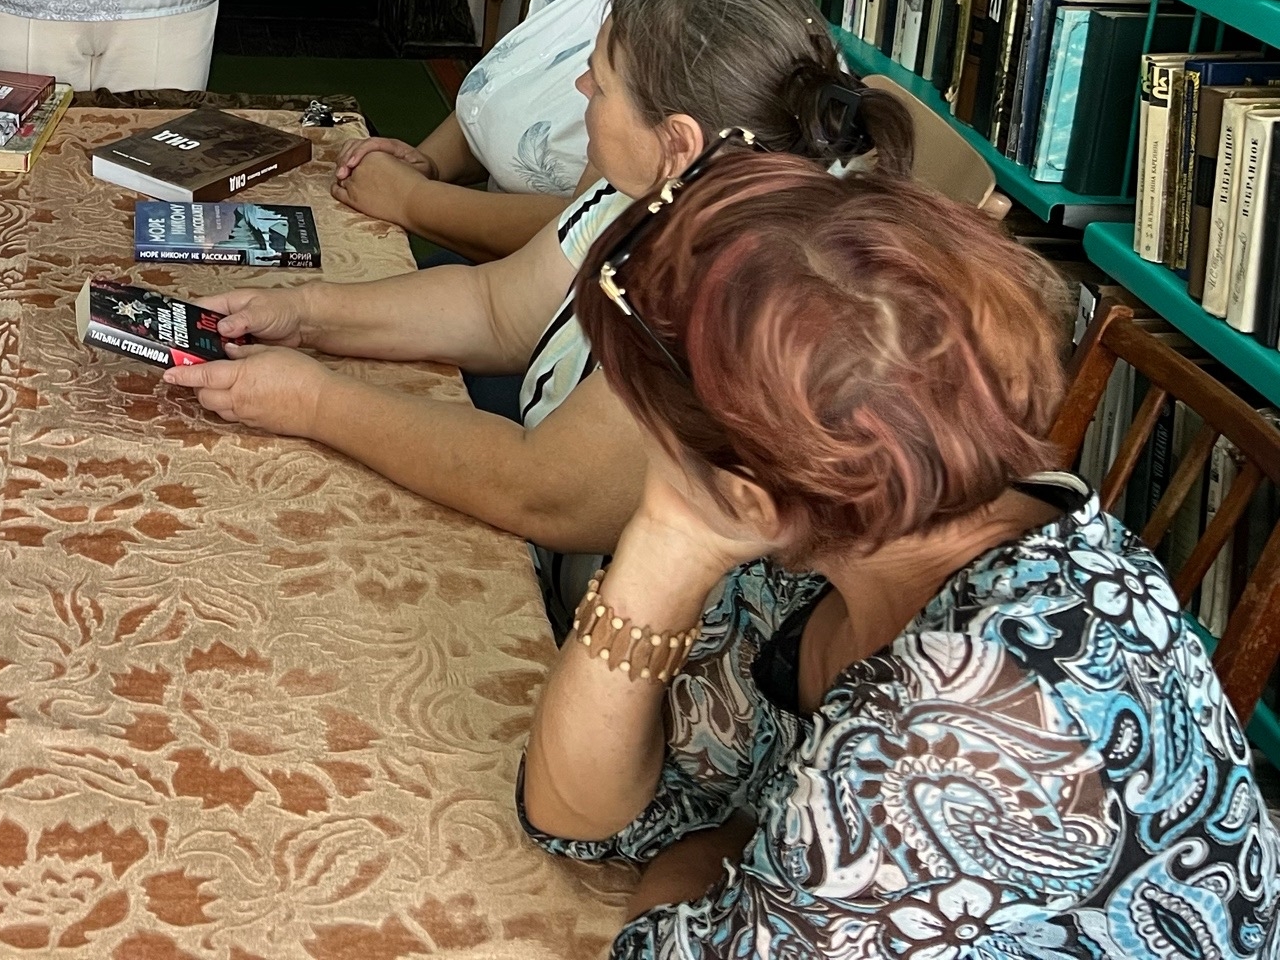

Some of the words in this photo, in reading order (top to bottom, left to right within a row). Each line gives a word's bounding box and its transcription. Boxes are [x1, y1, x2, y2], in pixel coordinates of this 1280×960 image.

[152, 129, 200, 150] СИД
[1220, 125, 1233, 203] ИЗБРАННОЕ
[1242, 137, 1259, 217] ИЗБРАННОЕ
[229, 173, 246, 192] СИД
[148, 218, 165, 242] МОРЕ
[169, 204, 187, 235] НИКОМУ
[191, 204, 204, 233] РАССКАЖЕТ
[139, 251, 159, 259] МОРЕ
[161, 251, 190, 260] НИКОМУ
[191, 252, 200, 260] НЕ
[201, 253, 242, 262] РАССКАЖЕТ
[289, 252, 312, 261] ЮРИЙ
[157, 307, 172, 341] ТАТЬЯНА
[172, 302, 190, 349] СТЕПАНОВА
[90, 329, 121, 347] ТАТЬЯНА
[120, 339, 170, 365] СТЕПАНОВА
